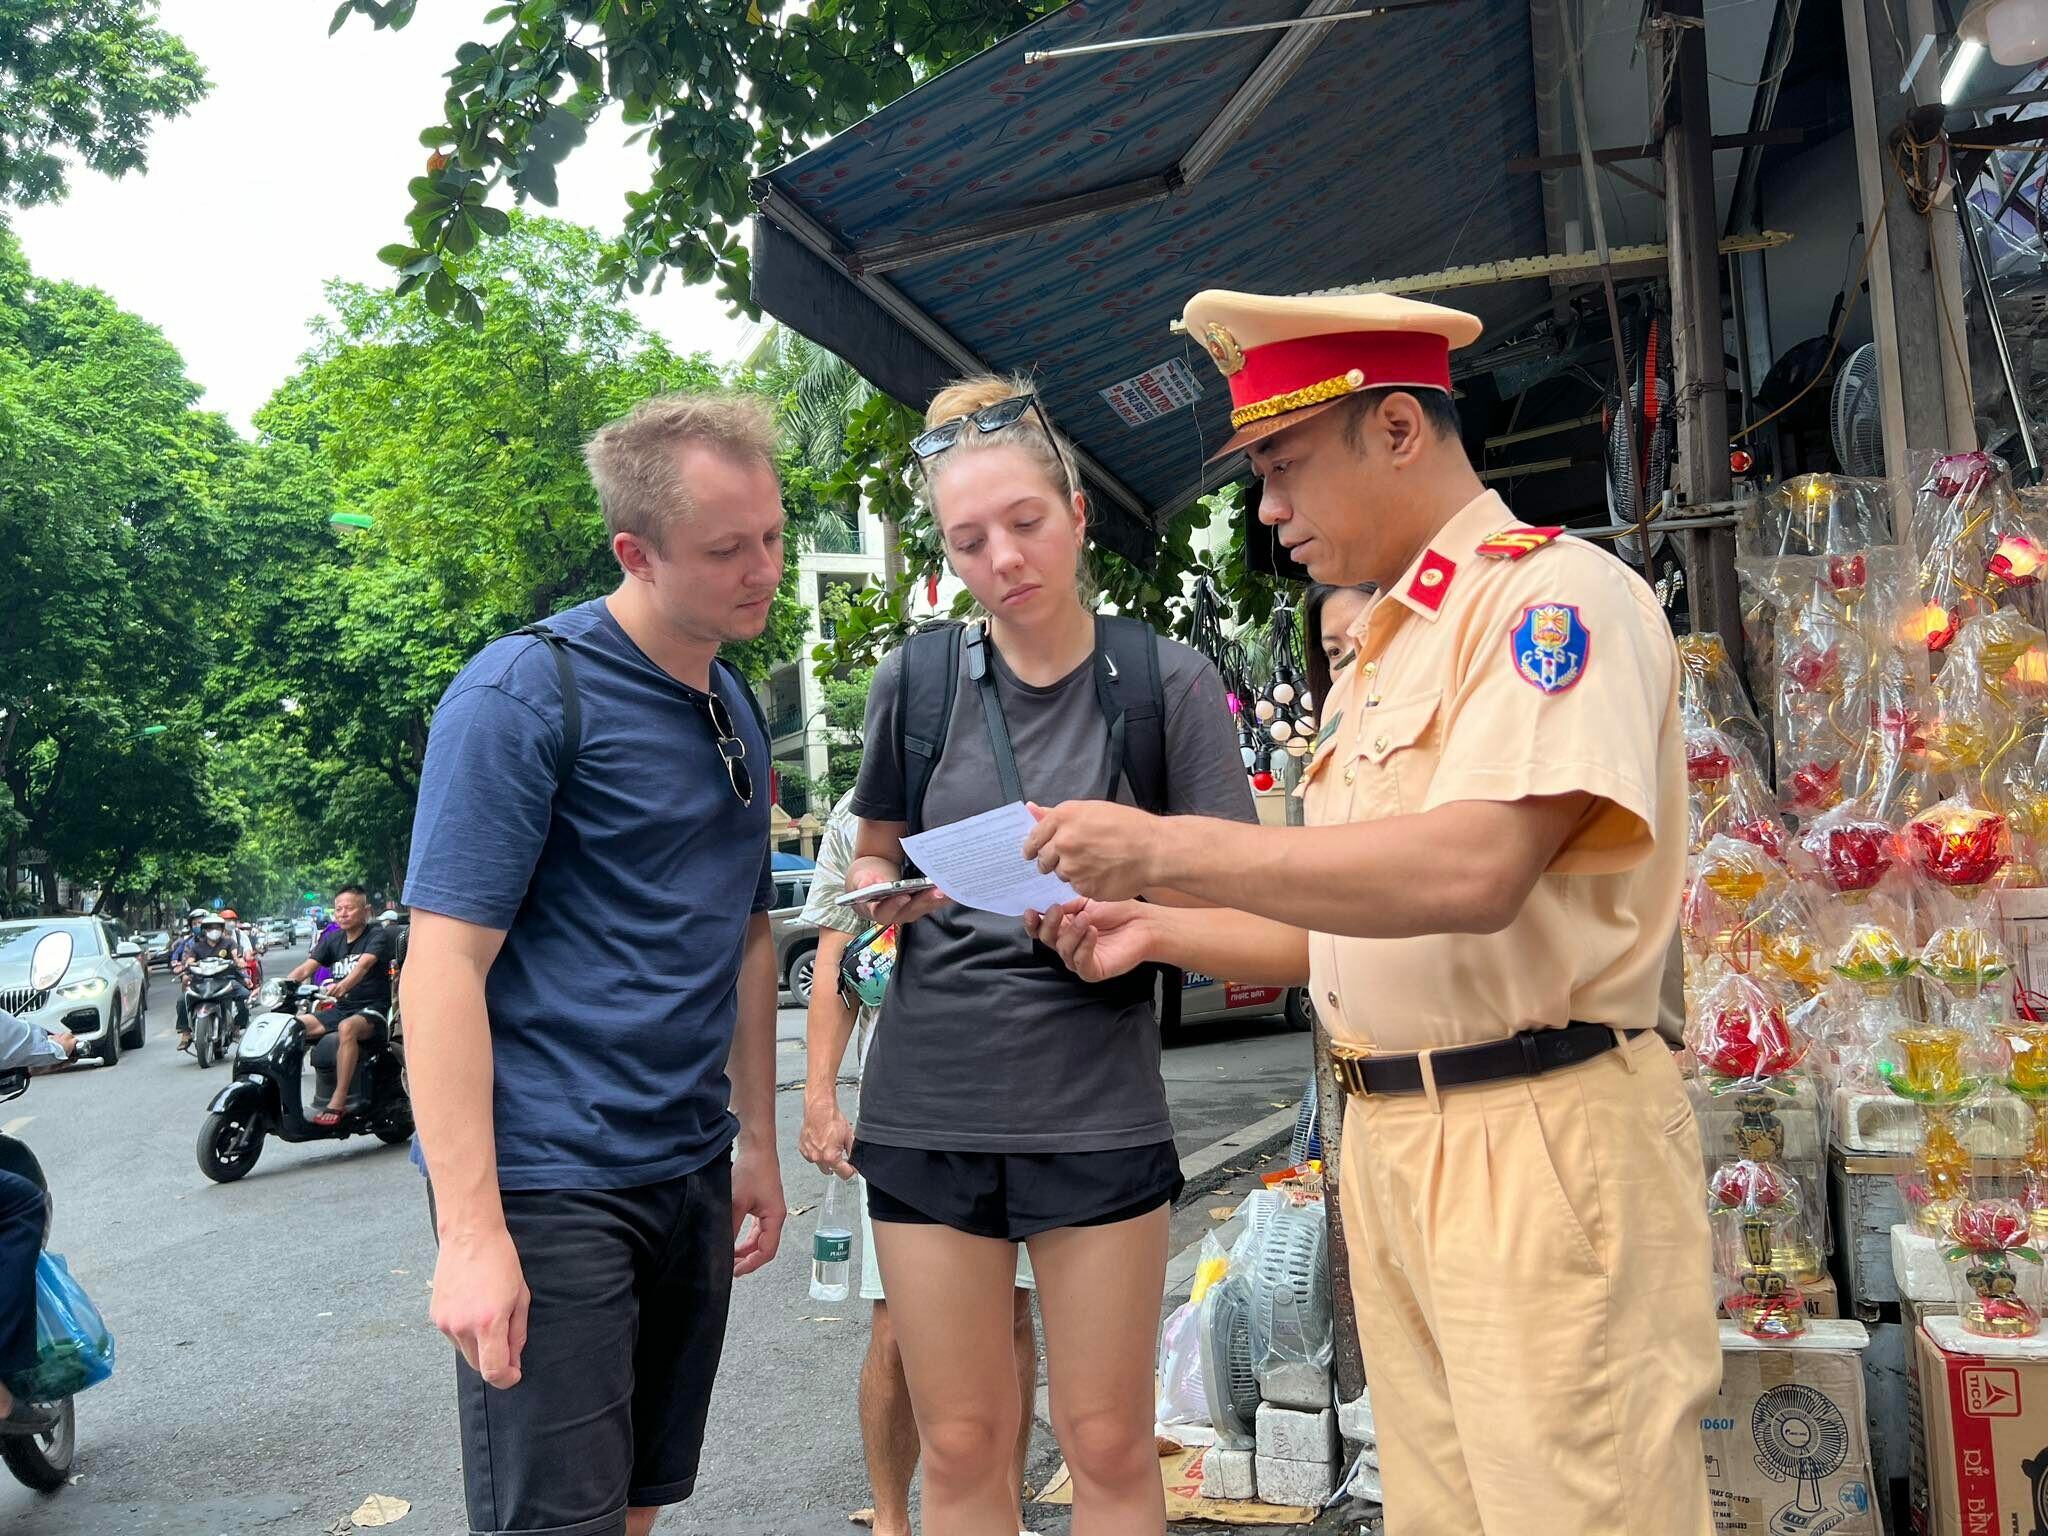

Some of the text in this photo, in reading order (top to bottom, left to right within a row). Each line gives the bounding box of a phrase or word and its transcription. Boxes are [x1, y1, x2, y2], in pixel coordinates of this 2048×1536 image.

[1969, 1375, 1982, 1410] TICO
[1757, 1457, 1784, 1480] 220V
[1963, 1449, 1991, 1477] RẺ
[1967, 1498, 1994, 1535] BỀN
